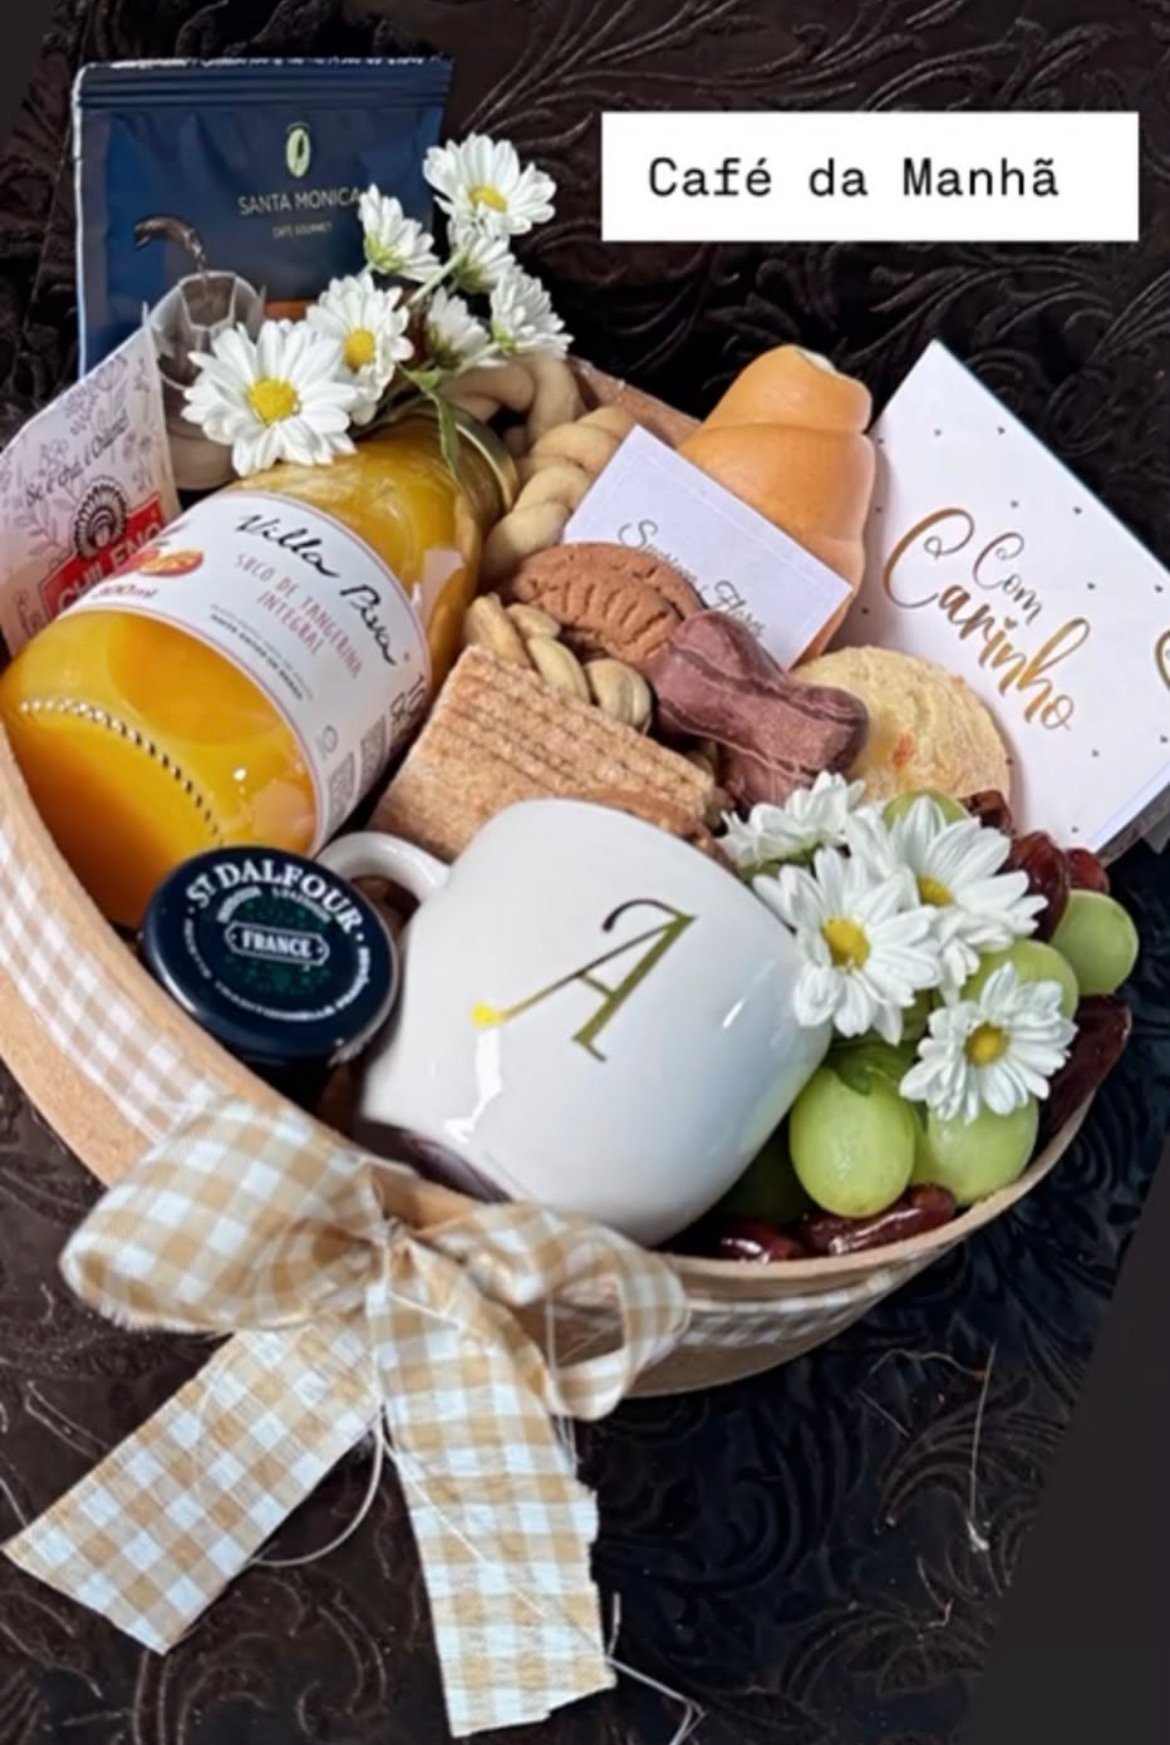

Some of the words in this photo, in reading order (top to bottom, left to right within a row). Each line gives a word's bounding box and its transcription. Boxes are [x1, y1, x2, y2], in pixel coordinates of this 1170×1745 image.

[238, 193, 291, 216] SANTA
[295, 187, 361, 210] MONICA
[235, 515, 340, 578] Villa
[972, 532, 1043, 625] Com
[236, 553, 275, 583] SUCO
[276, 574, 300, 599] DE
[299, 596, 364, 681] TANGERINA
[257, 591, 325, 657] INTEGRAL
[883, 508, 1091, 730] Carinho
[214, 858, 364, 934] DALFOUR
[242, 930, 312, 958] FRANCE
[469, 897, 699, 1063] A
